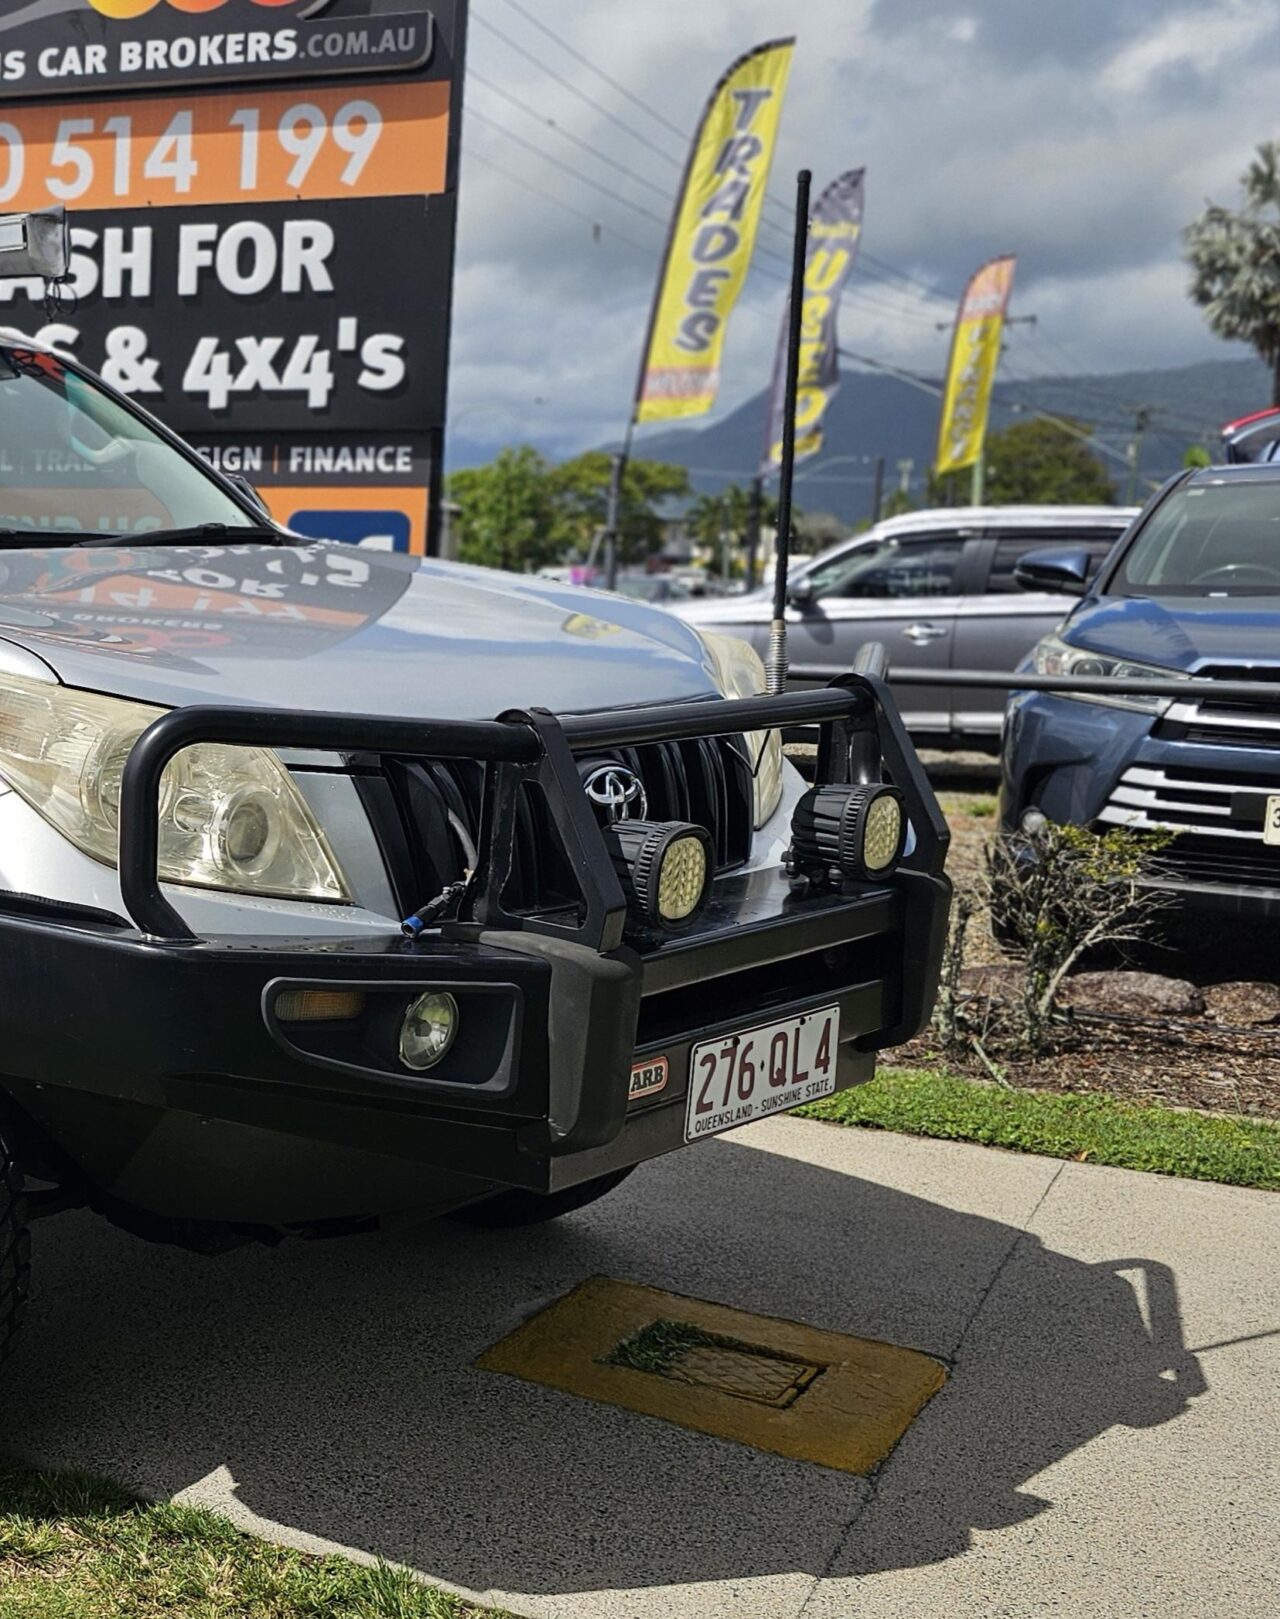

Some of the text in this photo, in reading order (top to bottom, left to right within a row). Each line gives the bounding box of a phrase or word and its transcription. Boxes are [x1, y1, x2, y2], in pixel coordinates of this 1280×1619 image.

[37, 44, 108, 79] CAR
[44, 110, 198, 201] 514
[226, 100, 384, 191] 199
[673, 88, 773, 354] TRADES
[177, 219, 335, 299] FOR
[100, 325, 163, 394] &
[288, 446, 414, 473] FINANCE
[631, 1064, 665, 1093] ARB
[694, 1103, 753, 1134] QUEENSLAND
[761, 1089, 802, 1113] SUNSHINE
[805, 1077, 830, 1098] STATE
